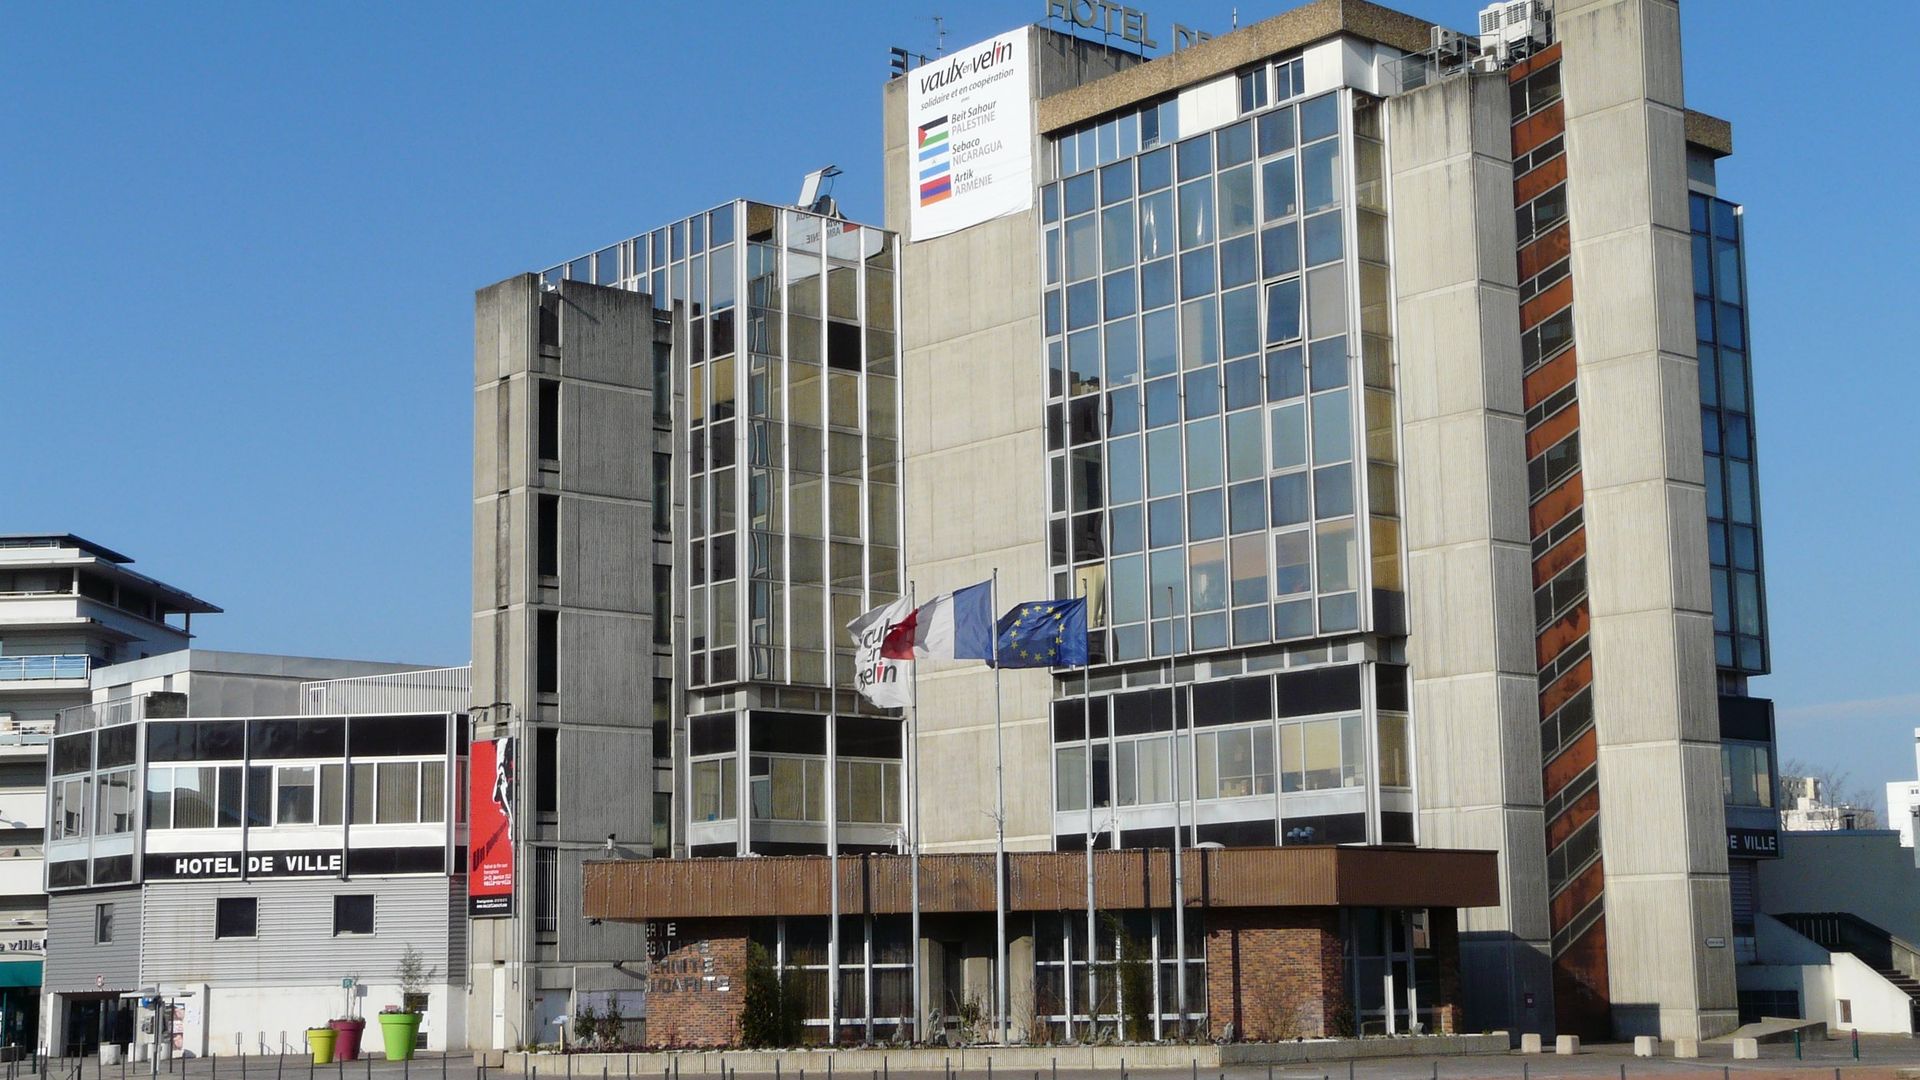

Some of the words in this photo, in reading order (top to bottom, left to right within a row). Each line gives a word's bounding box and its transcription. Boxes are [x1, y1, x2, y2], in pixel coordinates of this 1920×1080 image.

[920, 58, 965, 95] vaulx
[962, 63, 973, 74] en
[973, 41, 1012, 74] velin
[920, 92, 950, 111] solidaire
[951, 89, 958, 99] et
[959, 86, 968, 96] en
[951, 111, 967, 124] Beit
[967, 100, 997, 118] Sahour
[951, 111, 996, 136] PALESTINE
[952, 137, 981, 155] Sebaco
[953, 140, 1003, 167] NICARAGUA
[954, 168, 975, 184] Artik
[1727, 834, 1738, 849] E
[1744, 835, 1776, 851] VILLE
[175, 858, 239, 874] HOTEL
[248, 857, 273, 872] DE
[286, 855, 341, 871] VILLE
[8, 939, 42, 951] ville
